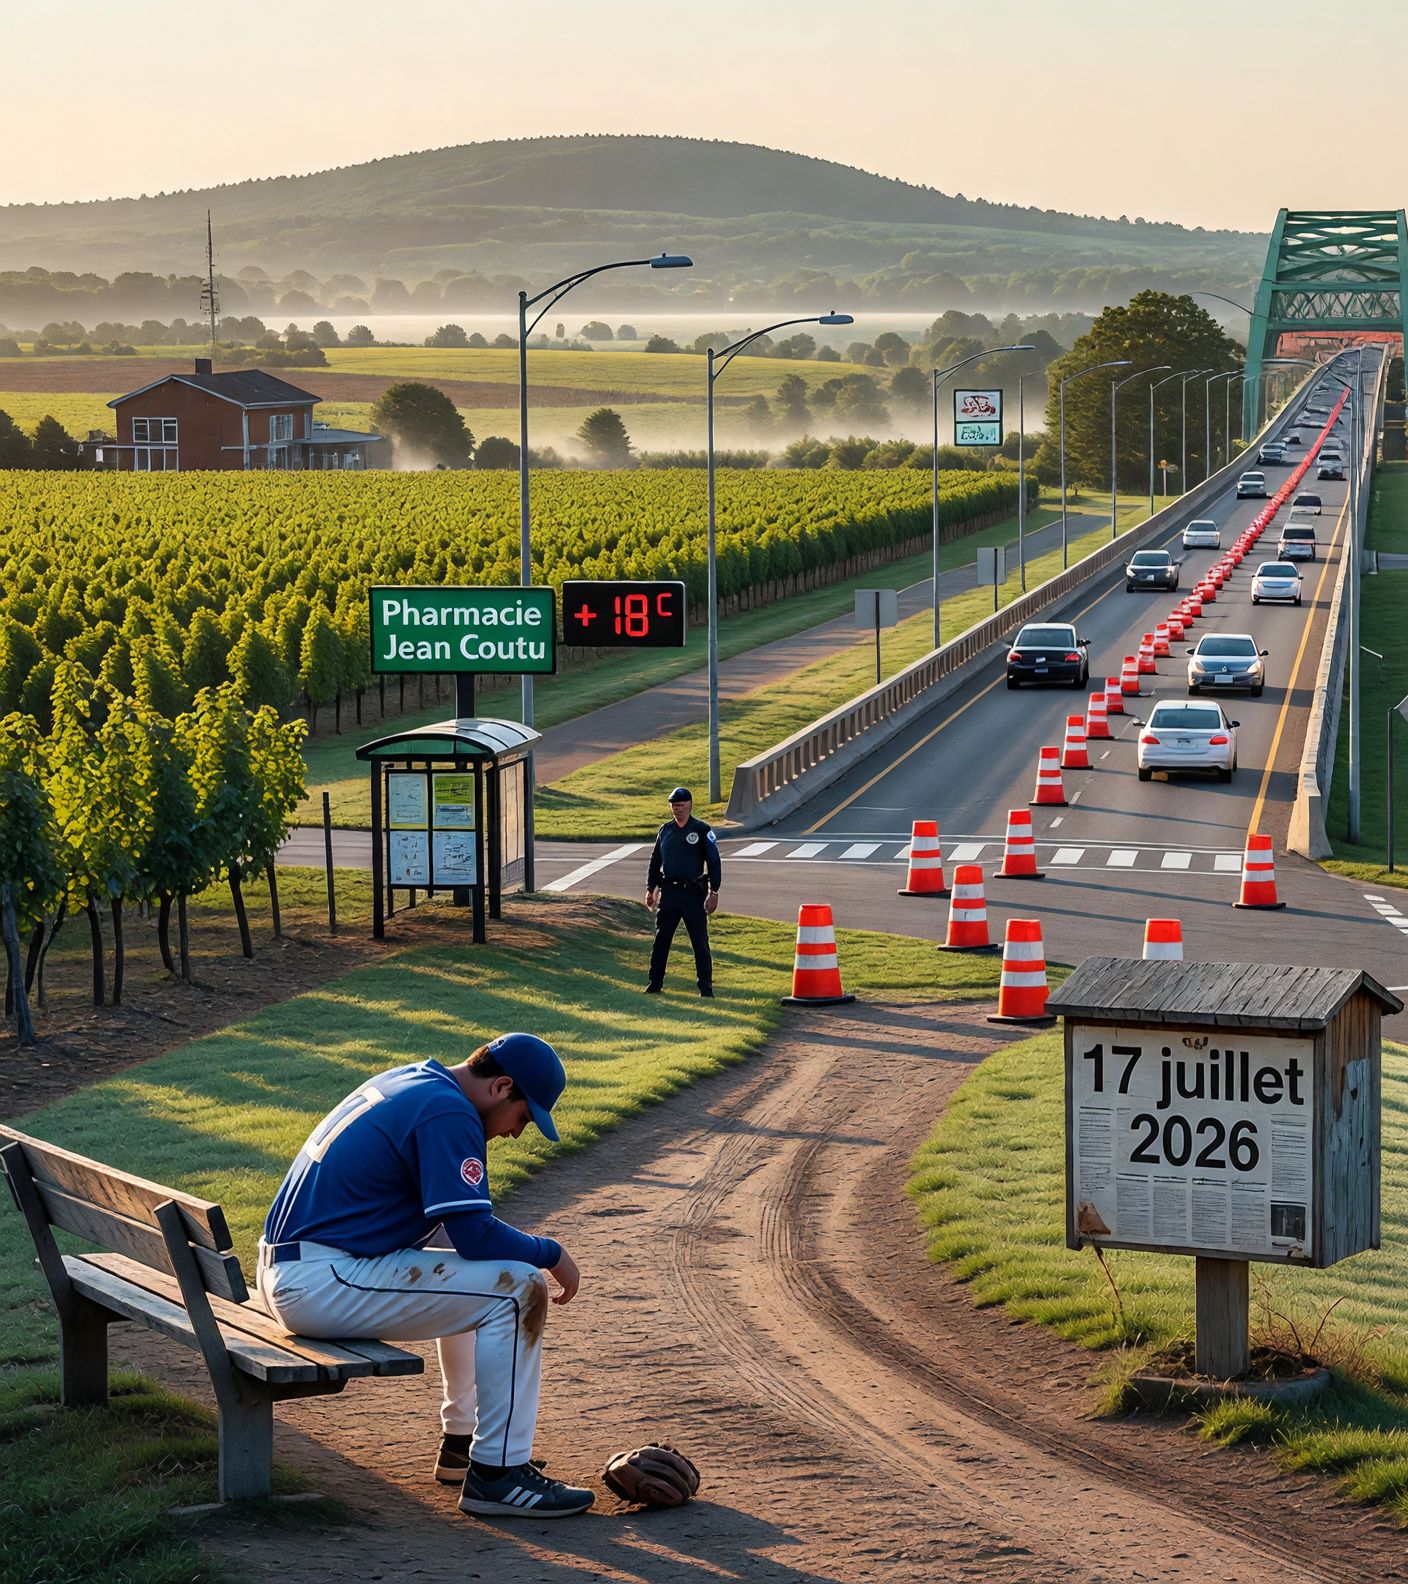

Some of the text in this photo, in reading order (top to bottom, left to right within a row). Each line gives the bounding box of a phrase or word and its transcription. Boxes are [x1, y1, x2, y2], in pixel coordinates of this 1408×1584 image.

[382, 598, 542, 626] Pharmacie
[383, 633, 545, 660] Jean Coutu
[1083, 1043, 1305, 1110] 17 juillet
[1129, 1113, 1260, 1172] 2026
